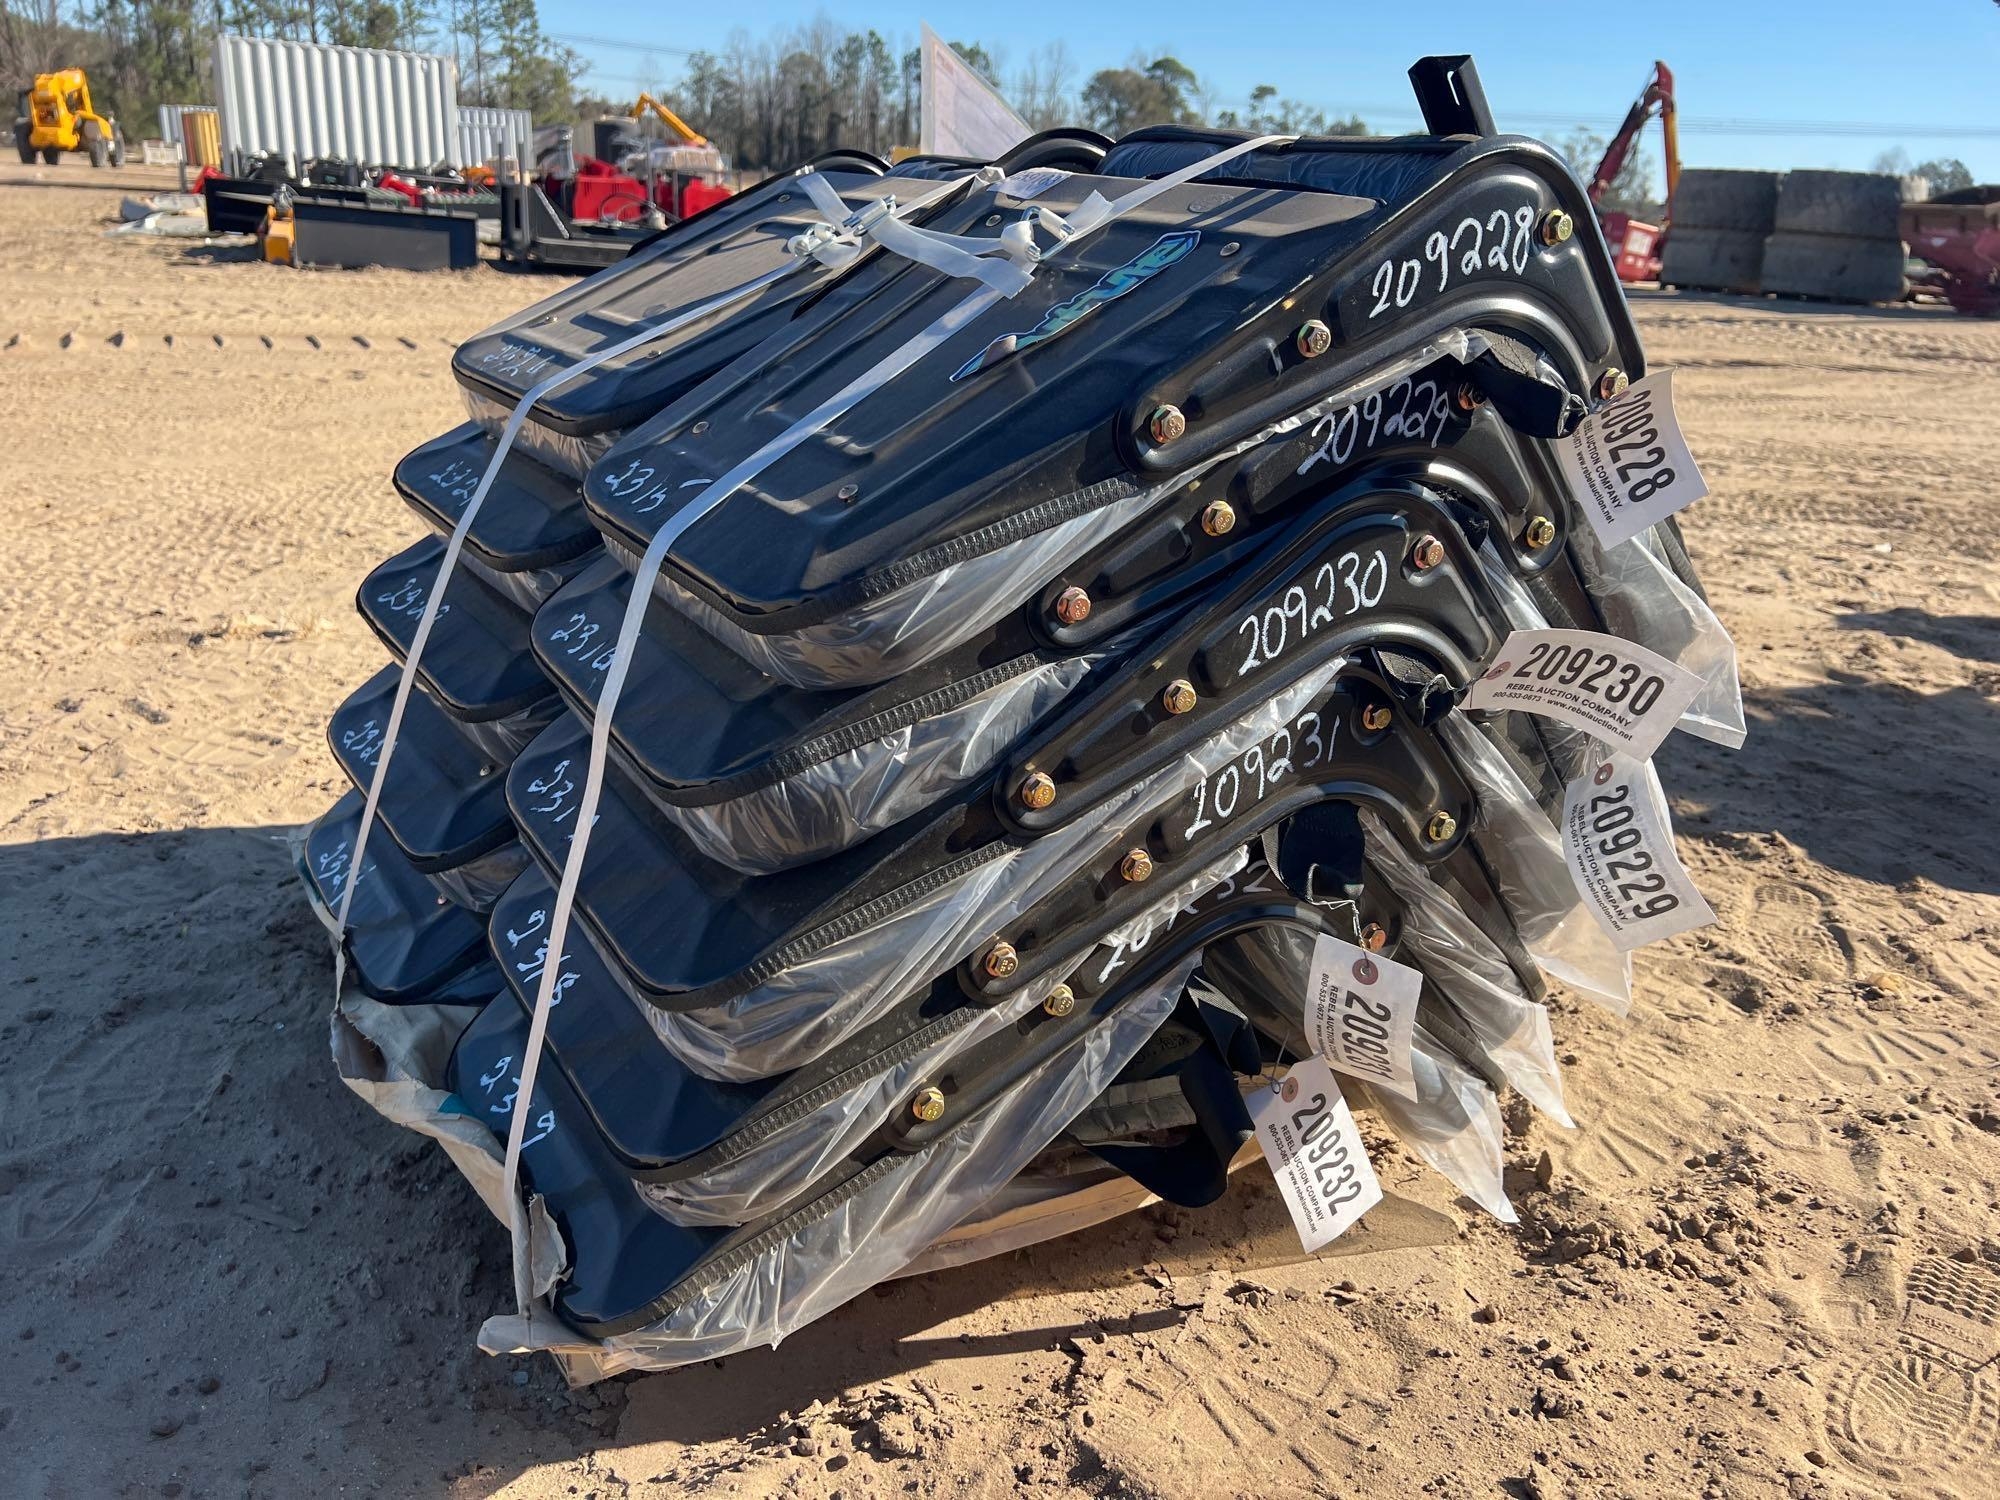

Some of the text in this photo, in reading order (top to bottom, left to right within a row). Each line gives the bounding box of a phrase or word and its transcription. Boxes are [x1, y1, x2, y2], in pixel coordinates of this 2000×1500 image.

[1369, 203, 1535, 319] 209228
[1296, 376, 1450, 476] 209229
[1600, 389, 1677, 503] 209228
[1576, 450, 1615, 525] www.rebelauction.net
[1585, 436, 1599, 466] AUCTION
[1599, 464, 1623, 510] COMPANY
[1237, 549, 1388, 677] 209230
[1505, 682, 1633, 728] REBEL AUCTION COMPANY
[1512, 642, 1666, 717] 209230
[1546, 697, 1634, 742] www.rebelauction.net
[1184, 711, 1341, 841] 209231
[1576, 853, 1624, 932] www.rebelauction.net
[1581, 834, 1601, 877] AUCTION
[1597, 877, 1629, 923] COMPANY
[1590, 784, 1680, 919] 209229
[1328, 984, 1339, 1017] REBEL
[1341, 990, 1396, 1081] 209231
[1280, 1124, 1325, 1222] REBEL AUCTION COMPANY
[1291, 1092, 1363, 1218] 209232
[1287, 1168, 1319, 1234] www.rebelauction.net
